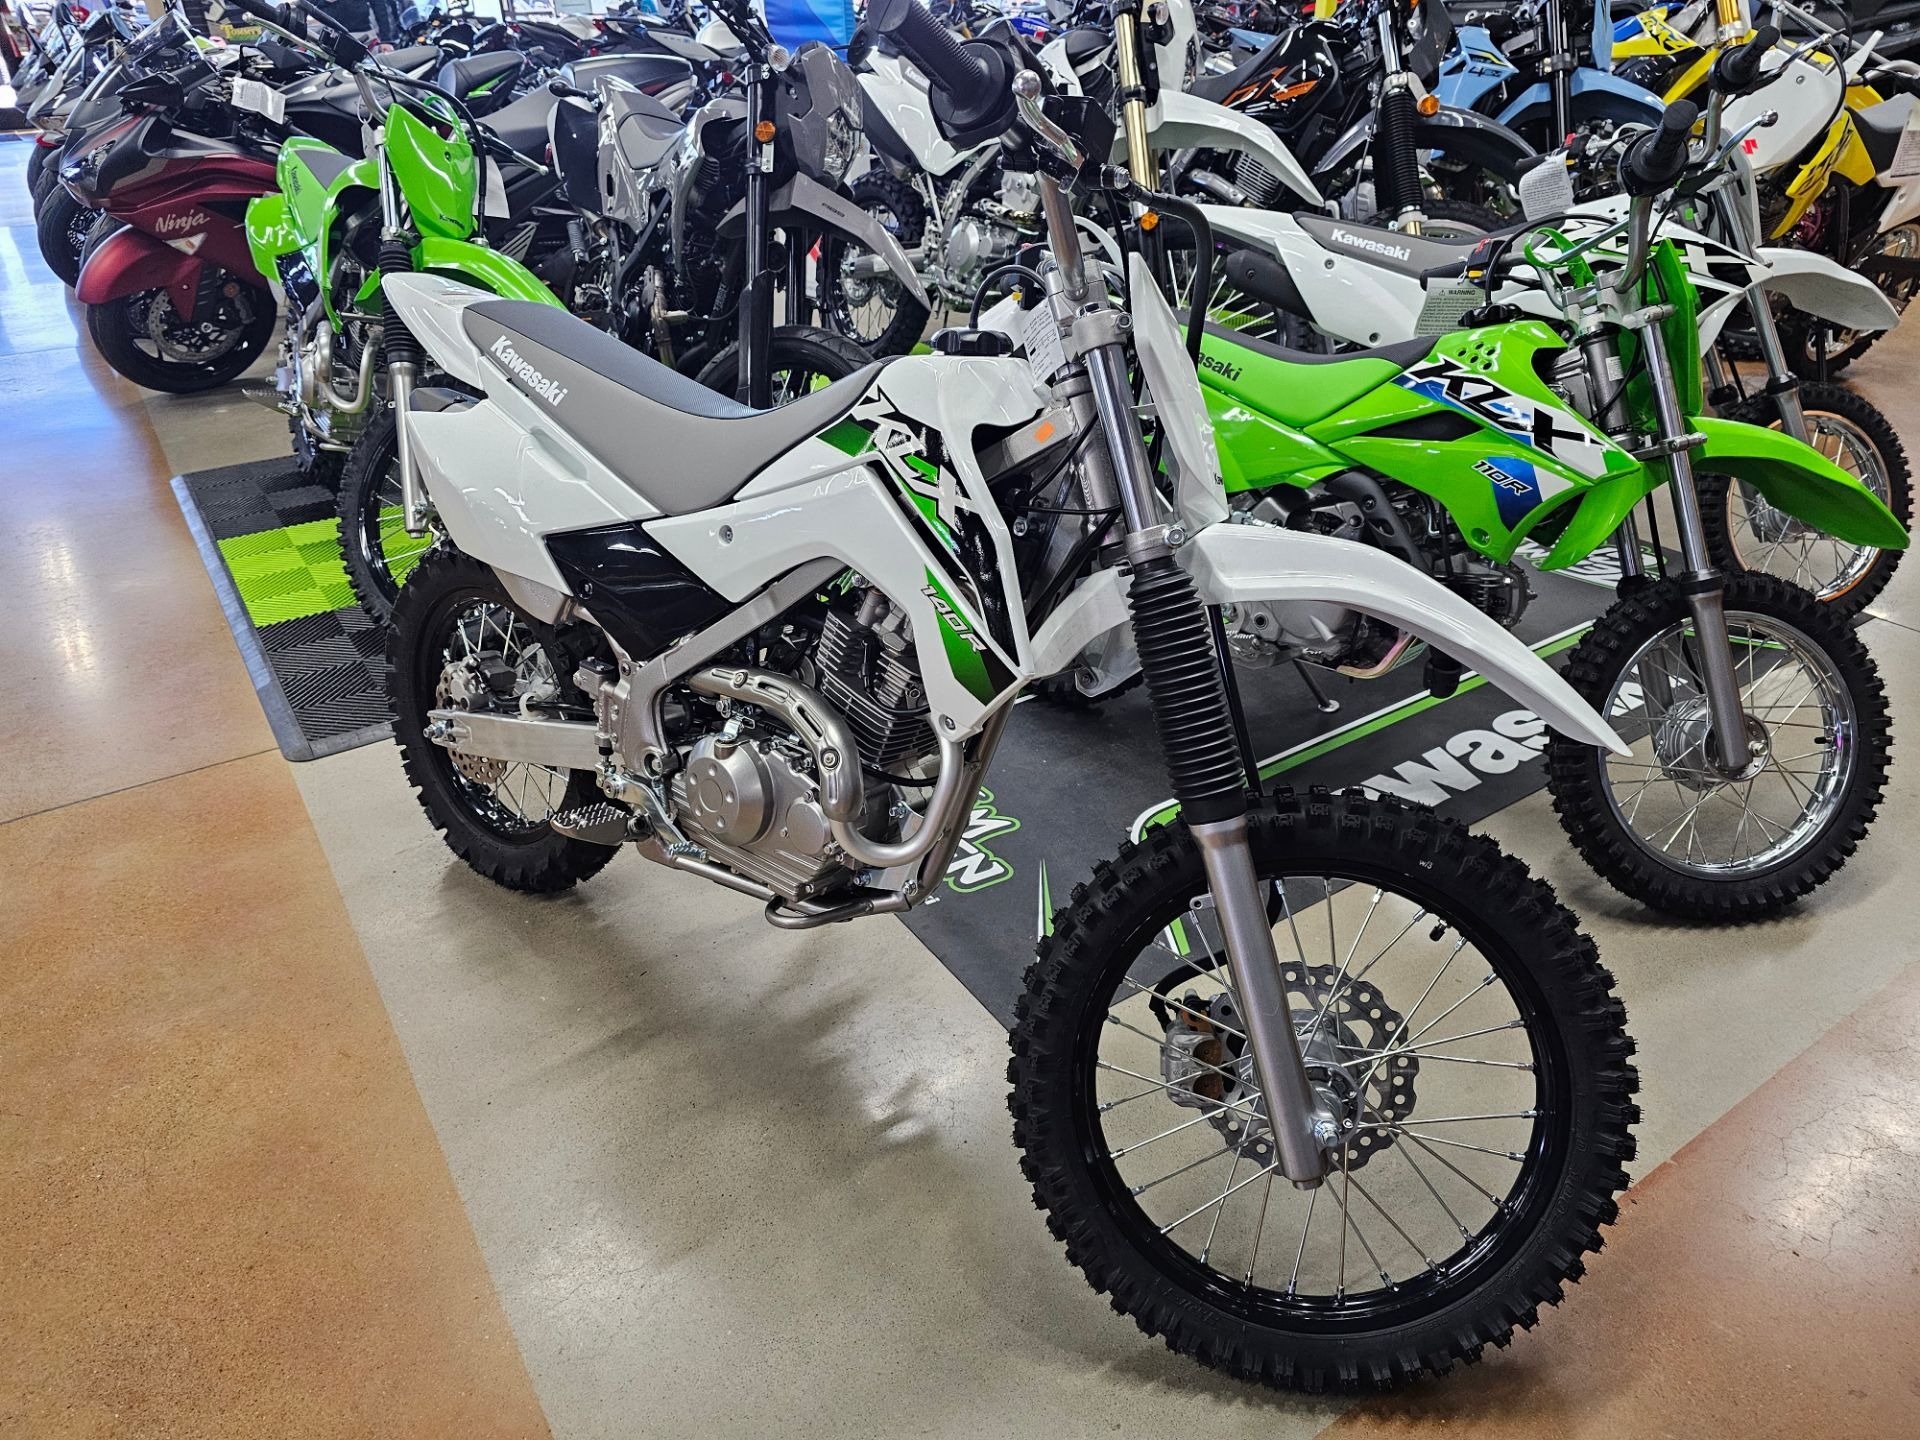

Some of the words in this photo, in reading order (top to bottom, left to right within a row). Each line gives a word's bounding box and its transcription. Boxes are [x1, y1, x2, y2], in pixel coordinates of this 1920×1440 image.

[155, 209, 211, 234] Ninja
[1331, 228, 1411, 261] Kawasaki
[490, 334, 568, 407] Kawasaki
[1198, 352, 1243, 381] asaki
[1404, 354, 1608, 461] KLX
[850, 385, 983, 537] KLX
[1471, 460, 1533, 496] 110R
[921, 584, 988, 654] 140R
